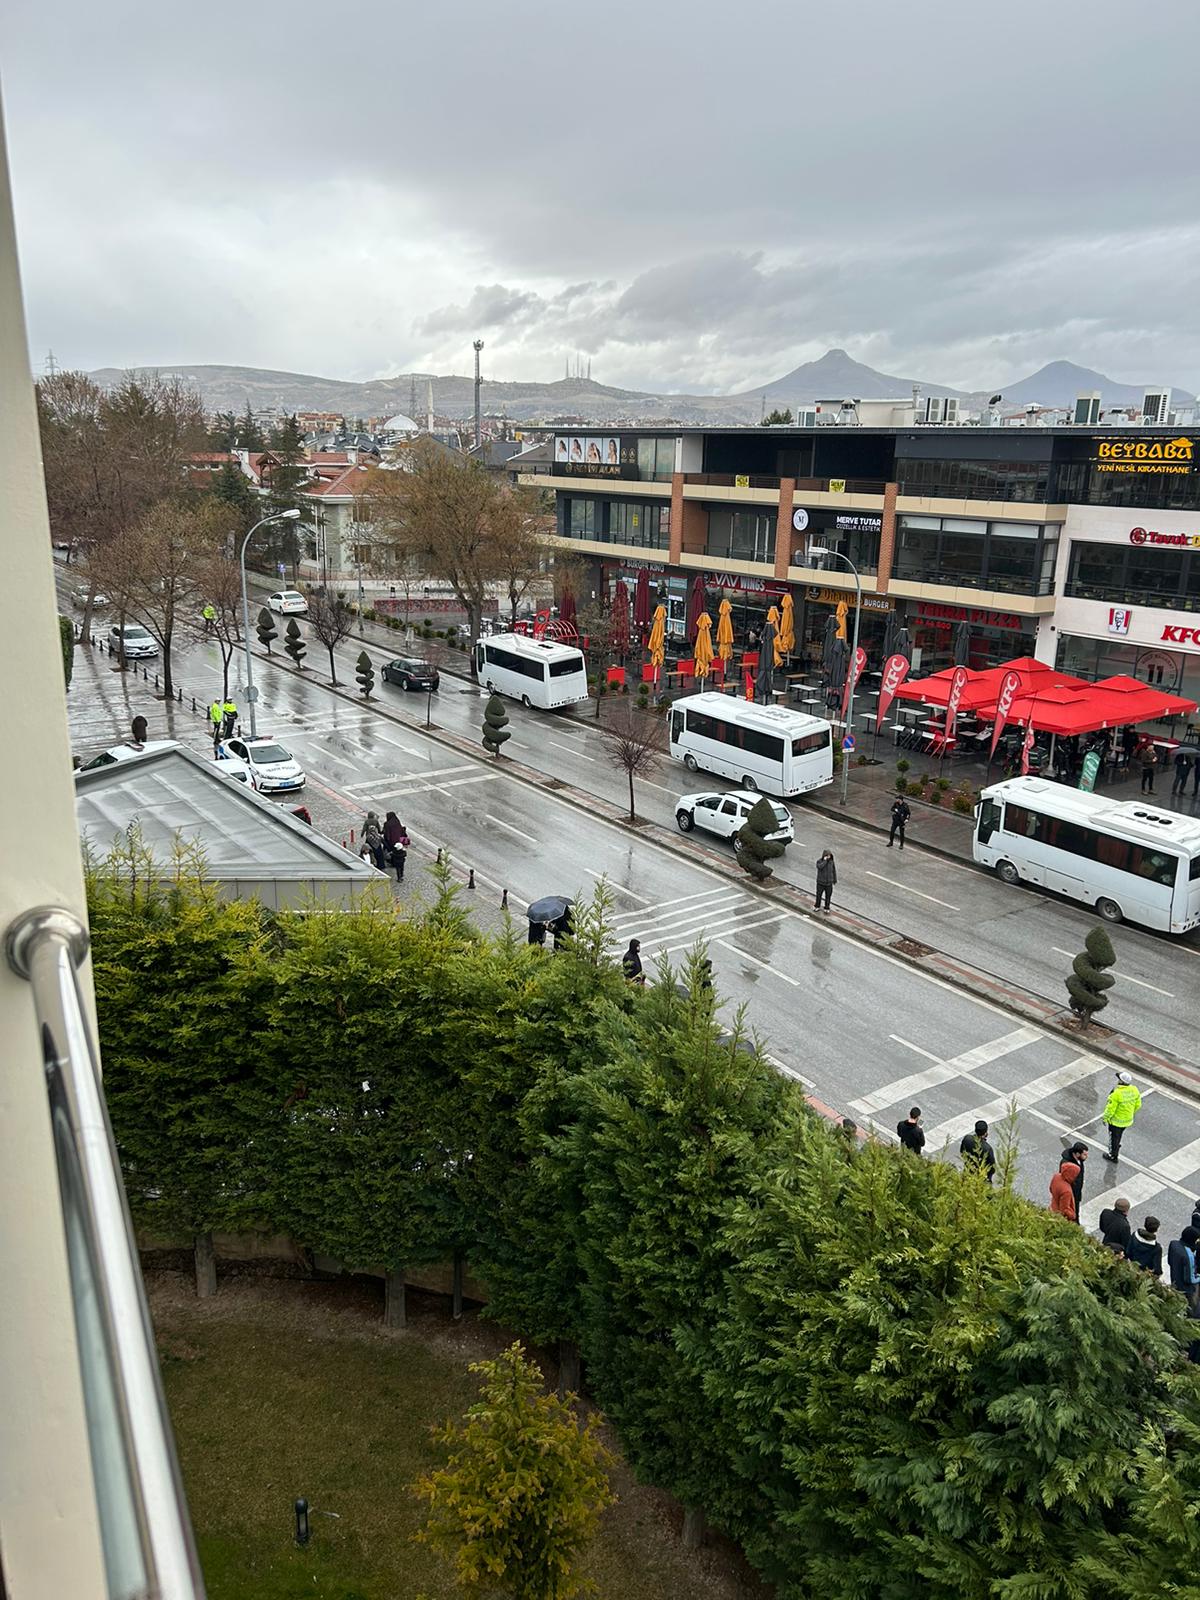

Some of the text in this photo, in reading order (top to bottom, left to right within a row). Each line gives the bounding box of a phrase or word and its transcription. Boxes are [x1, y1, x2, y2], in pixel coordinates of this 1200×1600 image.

[1098, 442, 1192, 459] BEYBABA
[1097, 464, 1114, 472] YENİ
[1137, 465, 1190, 474] KIRAATHANE
[836, 516, 882, 526] MERVE TUTAR
[1149, 531, 1187, 545] Tavuk
[626, 559, 665, 573] BURGER KING
[715, 573, 766, 592] VAV WINGS
[864, 599, 889, 609] BURGER
[883, 658, 904, 696] KFC
[1147, 664, 1164, 684] 11
[949, 672, 966, 713] KFC
[998, 676, 1018, 718] KFC
